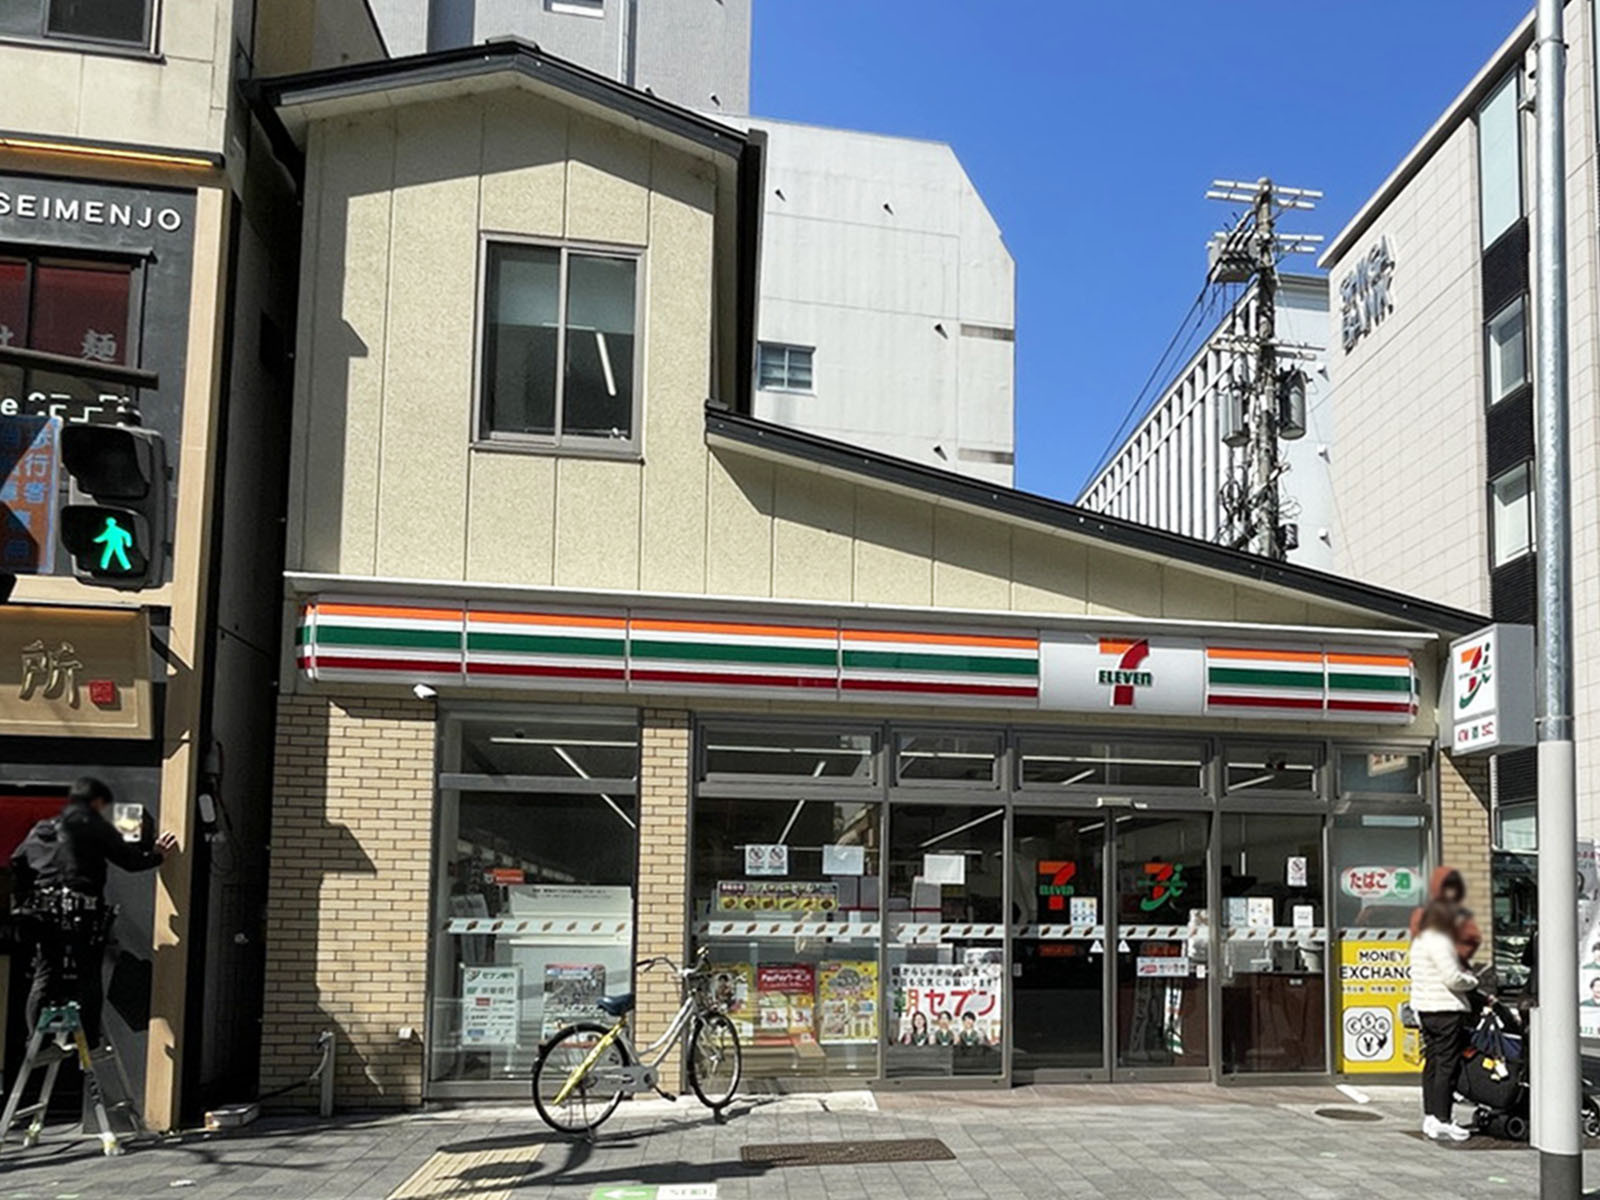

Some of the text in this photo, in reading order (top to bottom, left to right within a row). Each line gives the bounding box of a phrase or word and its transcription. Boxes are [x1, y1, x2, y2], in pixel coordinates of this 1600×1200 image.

[1349, 872, 1388, 889] たばこ
[1359, 951, 1406, 961] MONEY
